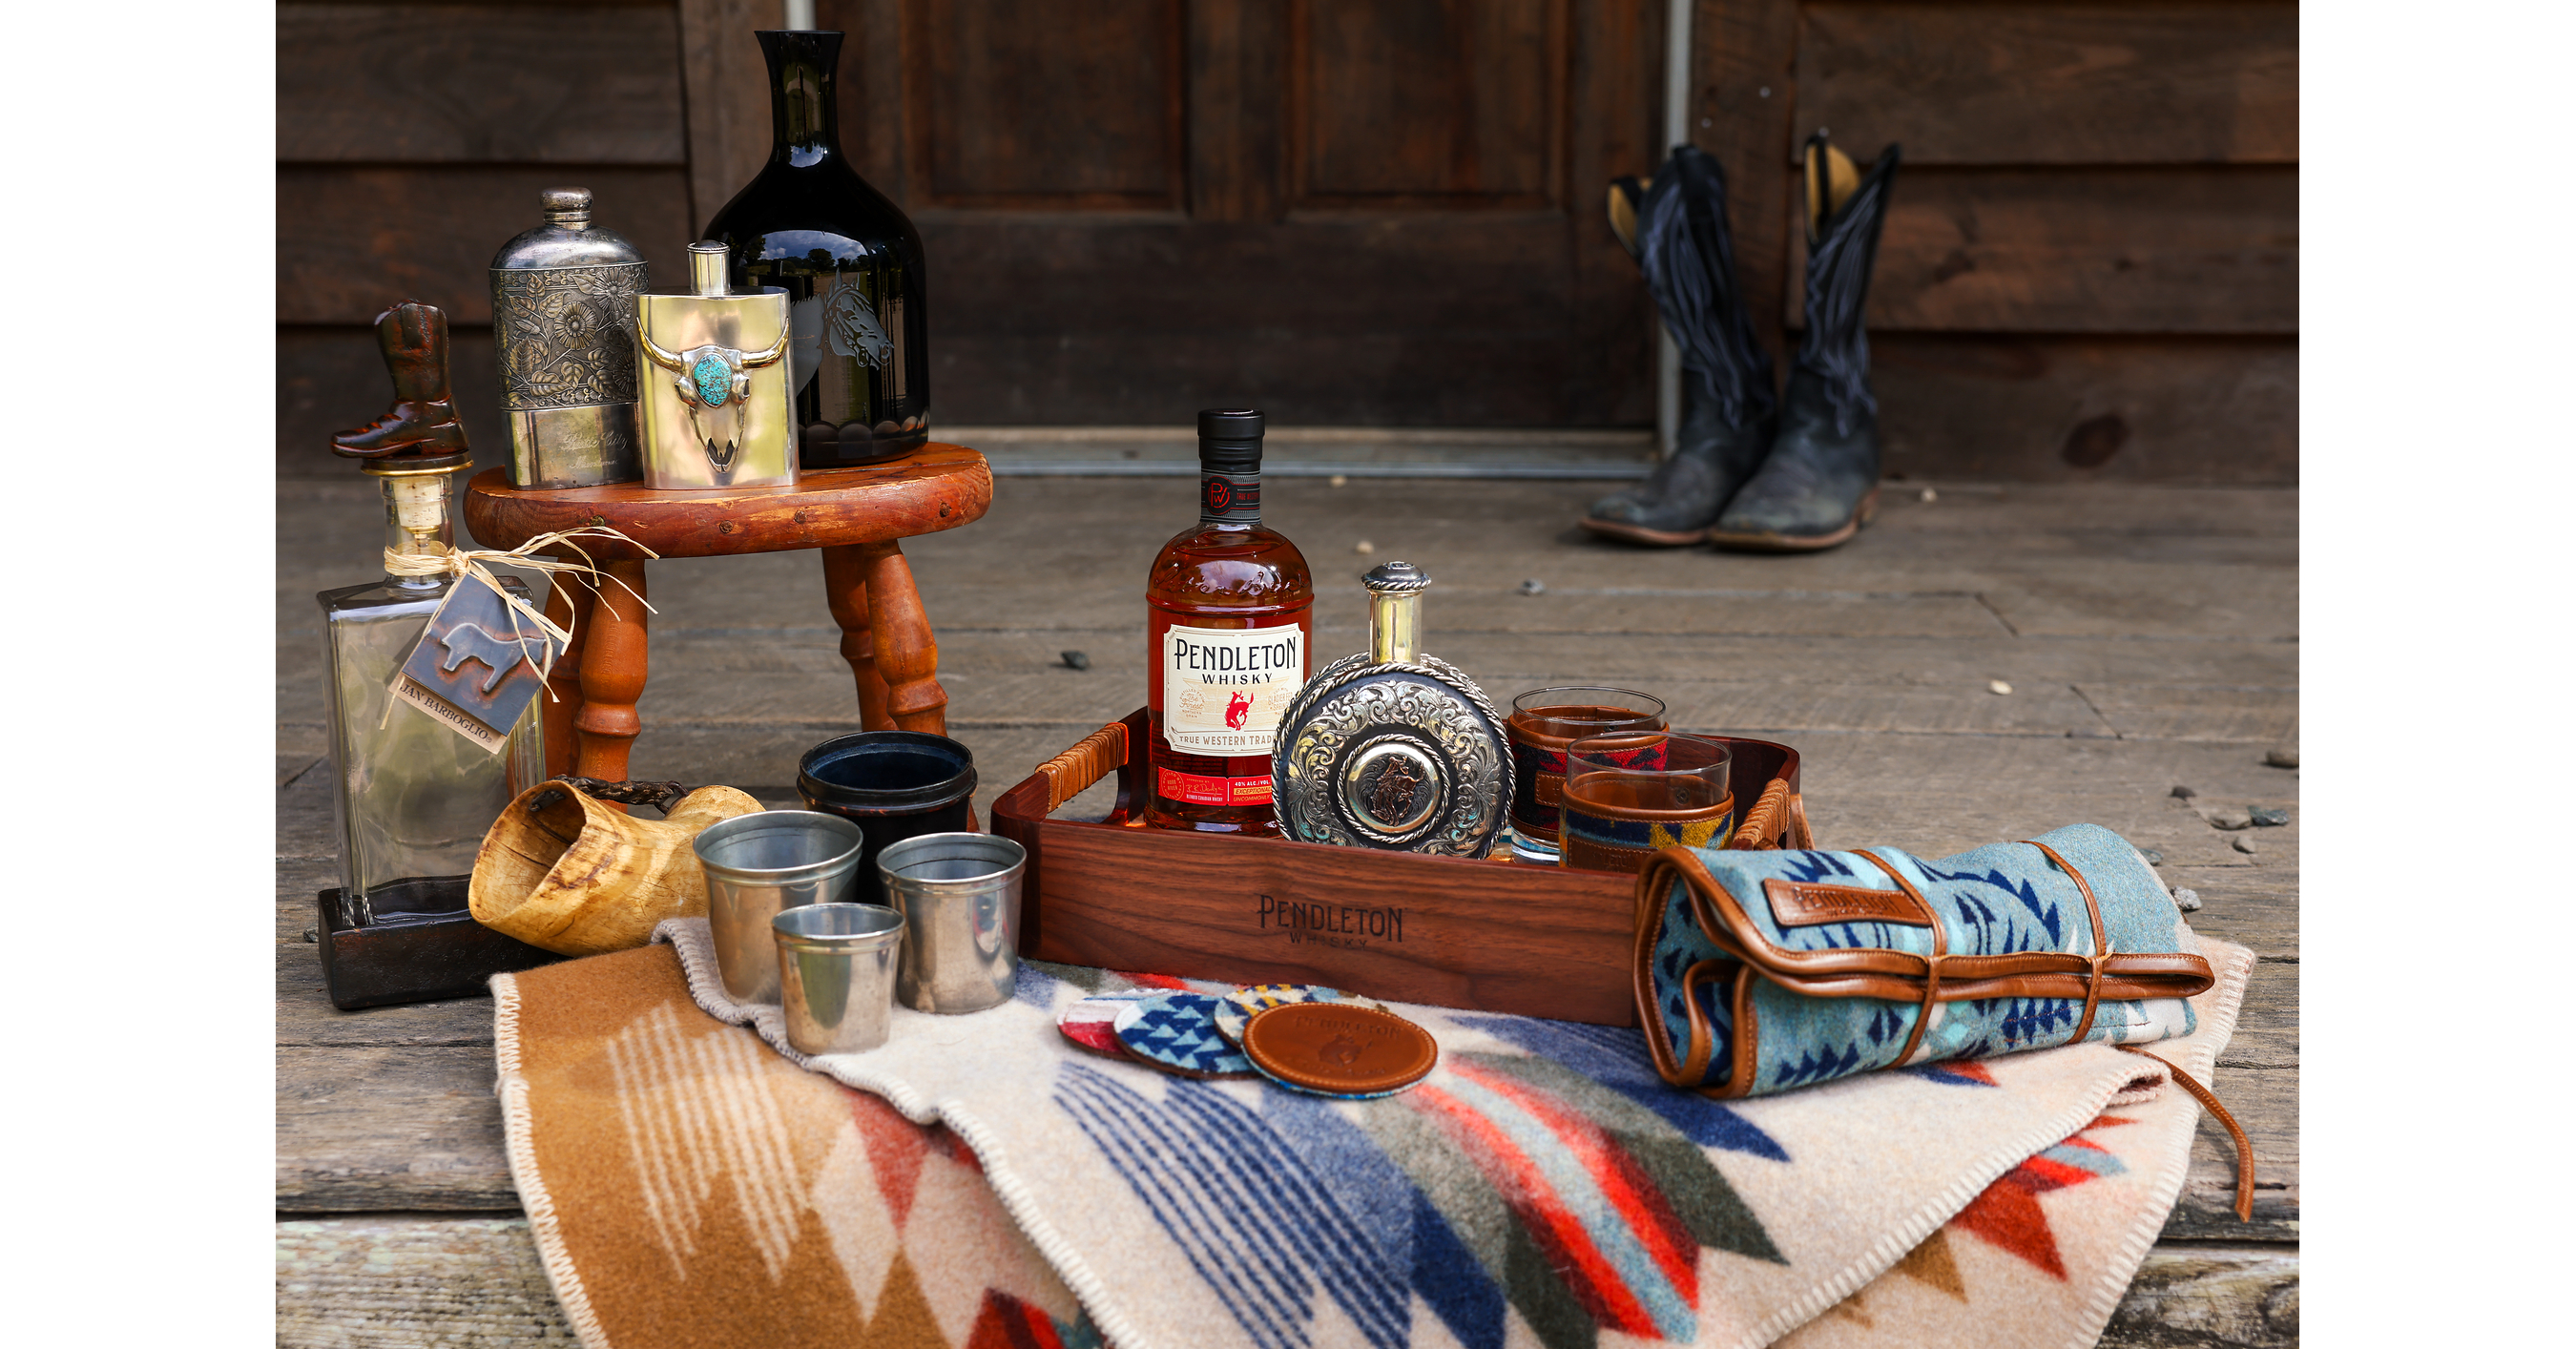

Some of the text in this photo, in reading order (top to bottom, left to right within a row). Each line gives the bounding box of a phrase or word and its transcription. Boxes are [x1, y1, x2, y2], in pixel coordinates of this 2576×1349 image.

[1174, 636, 1296, 671] PENDLETON
[1202, 673, 1272, 685] WHISKY
[400, 684, 425, 701] JAN
[1179, 736, 1199, 744] TRUE
[1203, 736, 1246, 746] WESTERN
[1791, 886, 1901, 914] PENDLETON
[1257, 895, 1402, 943] PENDLETON
[1290, 932, 1368, 951] WHISKY
[1296, 1015, 1402, 1040] PENDLETON
